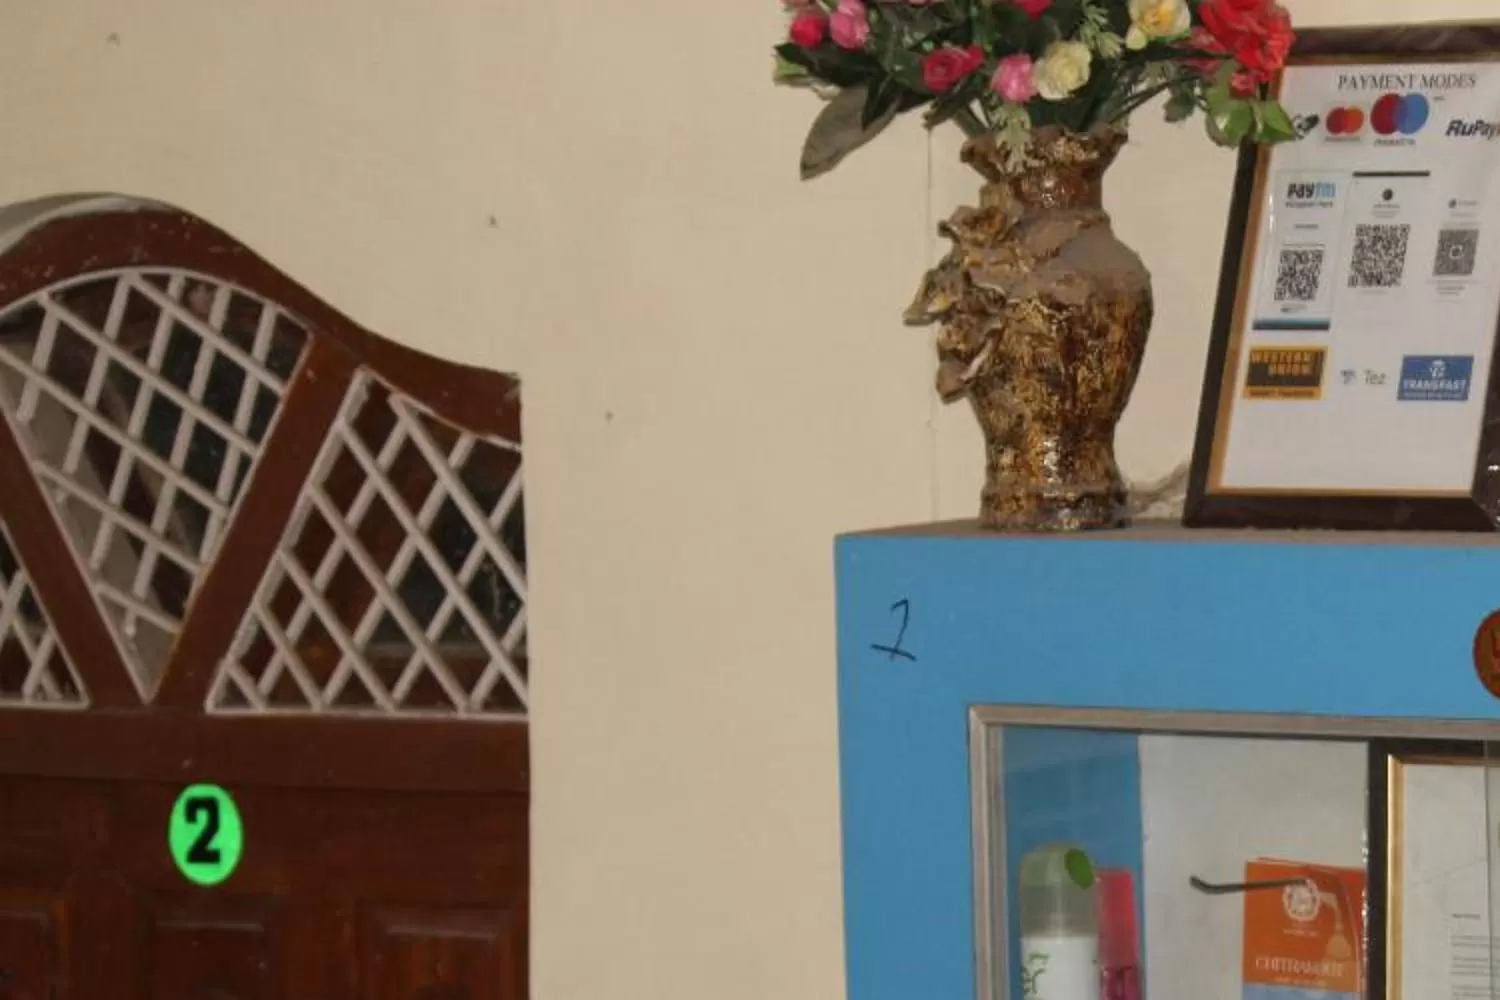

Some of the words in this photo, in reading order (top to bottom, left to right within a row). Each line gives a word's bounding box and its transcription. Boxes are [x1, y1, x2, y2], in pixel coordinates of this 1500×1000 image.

[1337, 74, 1415, 90] PAYMENT
[1419, 72, 1477, 89] MODES
[184, 795, 222, 865] 2
